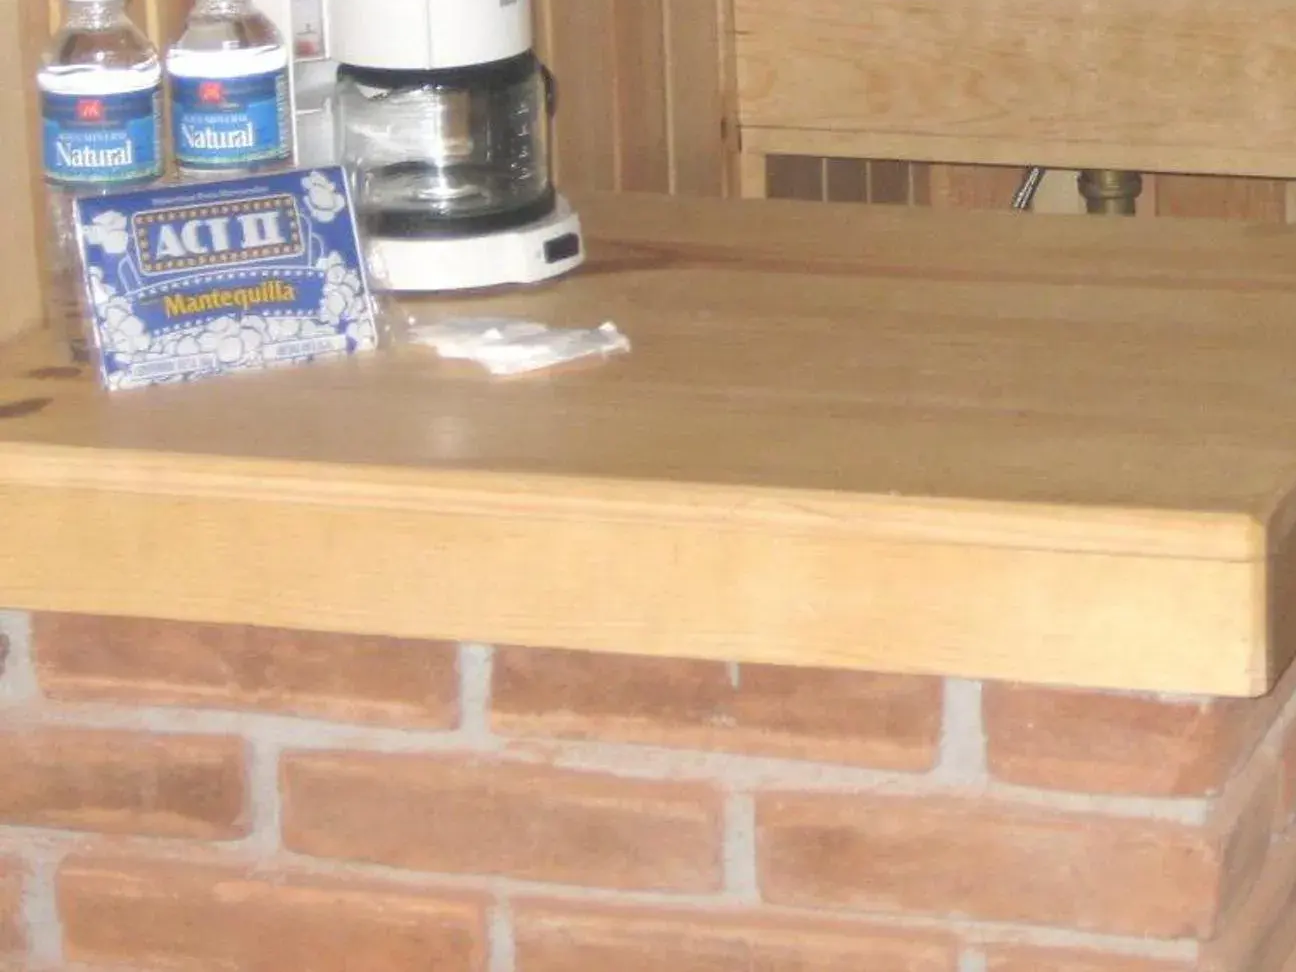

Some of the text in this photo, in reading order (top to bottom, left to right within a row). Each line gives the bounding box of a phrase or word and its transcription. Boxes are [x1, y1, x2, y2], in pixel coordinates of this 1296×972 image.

[181, 122, 254, 150] Natural
[55, 139, 133, 168] Natural
[155, 211, 287, 260] ACT II
[163, 280, 296, 318] Mantequilla
